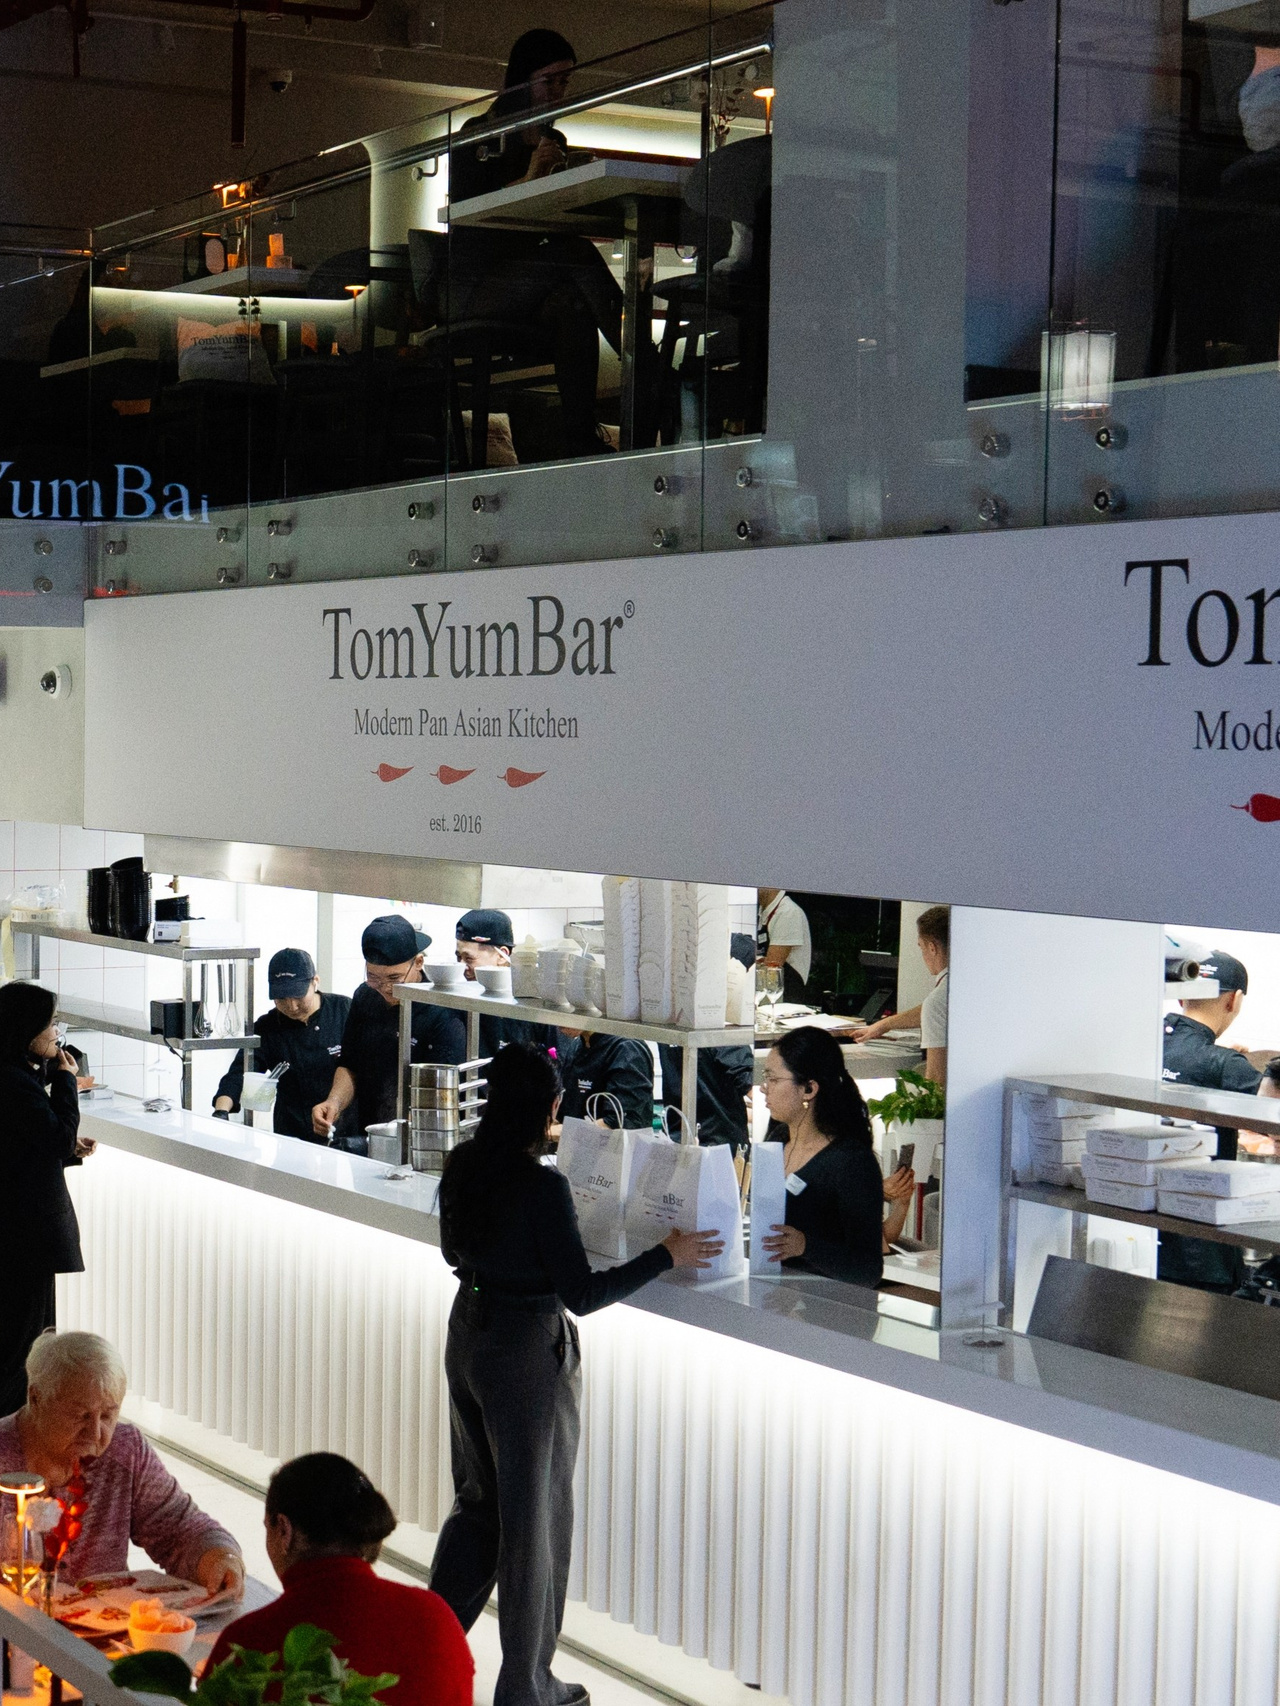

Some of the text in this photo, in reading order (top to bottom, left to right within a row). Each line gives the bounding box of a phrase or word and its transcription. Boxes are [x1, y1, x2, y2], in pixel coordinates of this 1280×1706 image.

[353, 708, 579, 738] Modern Pan Asian Kitchen
[1192, 709, 1280, 751] Mod
[429, 814, 482, 834] est. 2016
